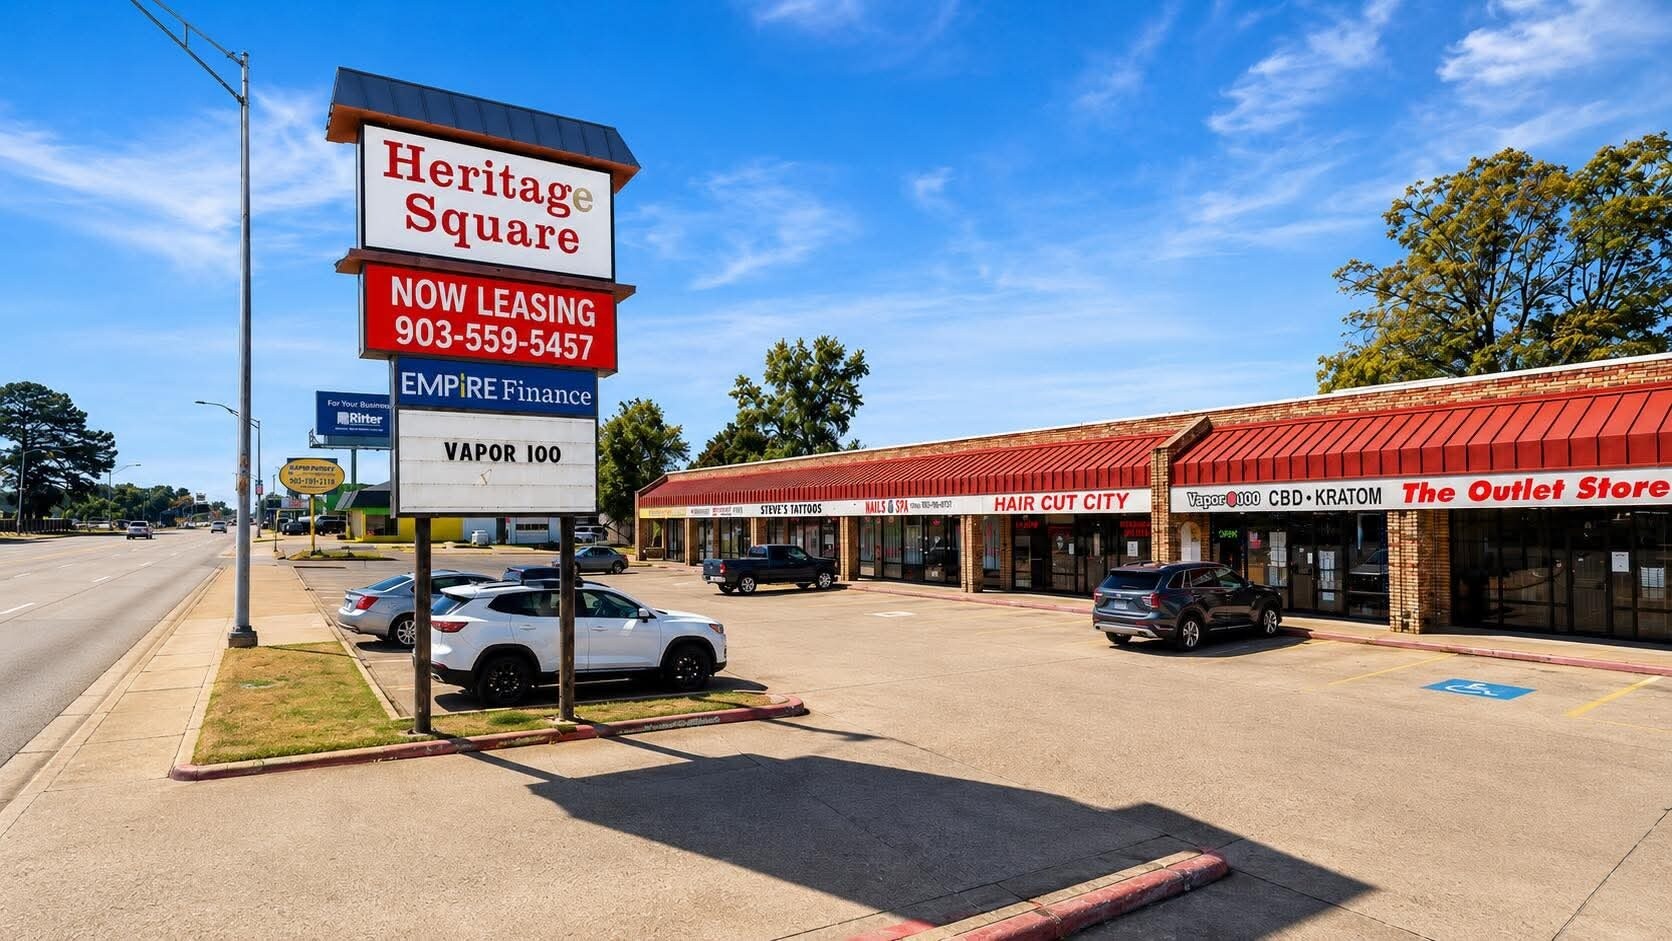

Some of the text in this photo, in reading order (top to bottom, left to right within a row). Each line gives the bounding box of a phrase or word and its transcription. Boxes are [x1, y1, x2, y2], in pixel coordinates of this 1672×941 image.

[383, 139, 593, 218] Heritage
[405, 193, 579, 254] Square
[391, 276, 596, 328] NOW LEASING
[395, 315, 594, 361] 903-559-5457
[502, 379, 592, 406] Finance
[444, 442, 561, 463] VAPOR 100
[994, 492, 1130, 512] HAIR CUT CITY
[1187, 487, 1382, 510] Vapor 100 CBD KRATOM
[1402, 476, 1670, 503] The Outlet Store
[760, 503, 822, 515] STEVE'S TATTOOS
[866, 501, 886, 514] NAILS
[896, 500, 908, 512] SPA
